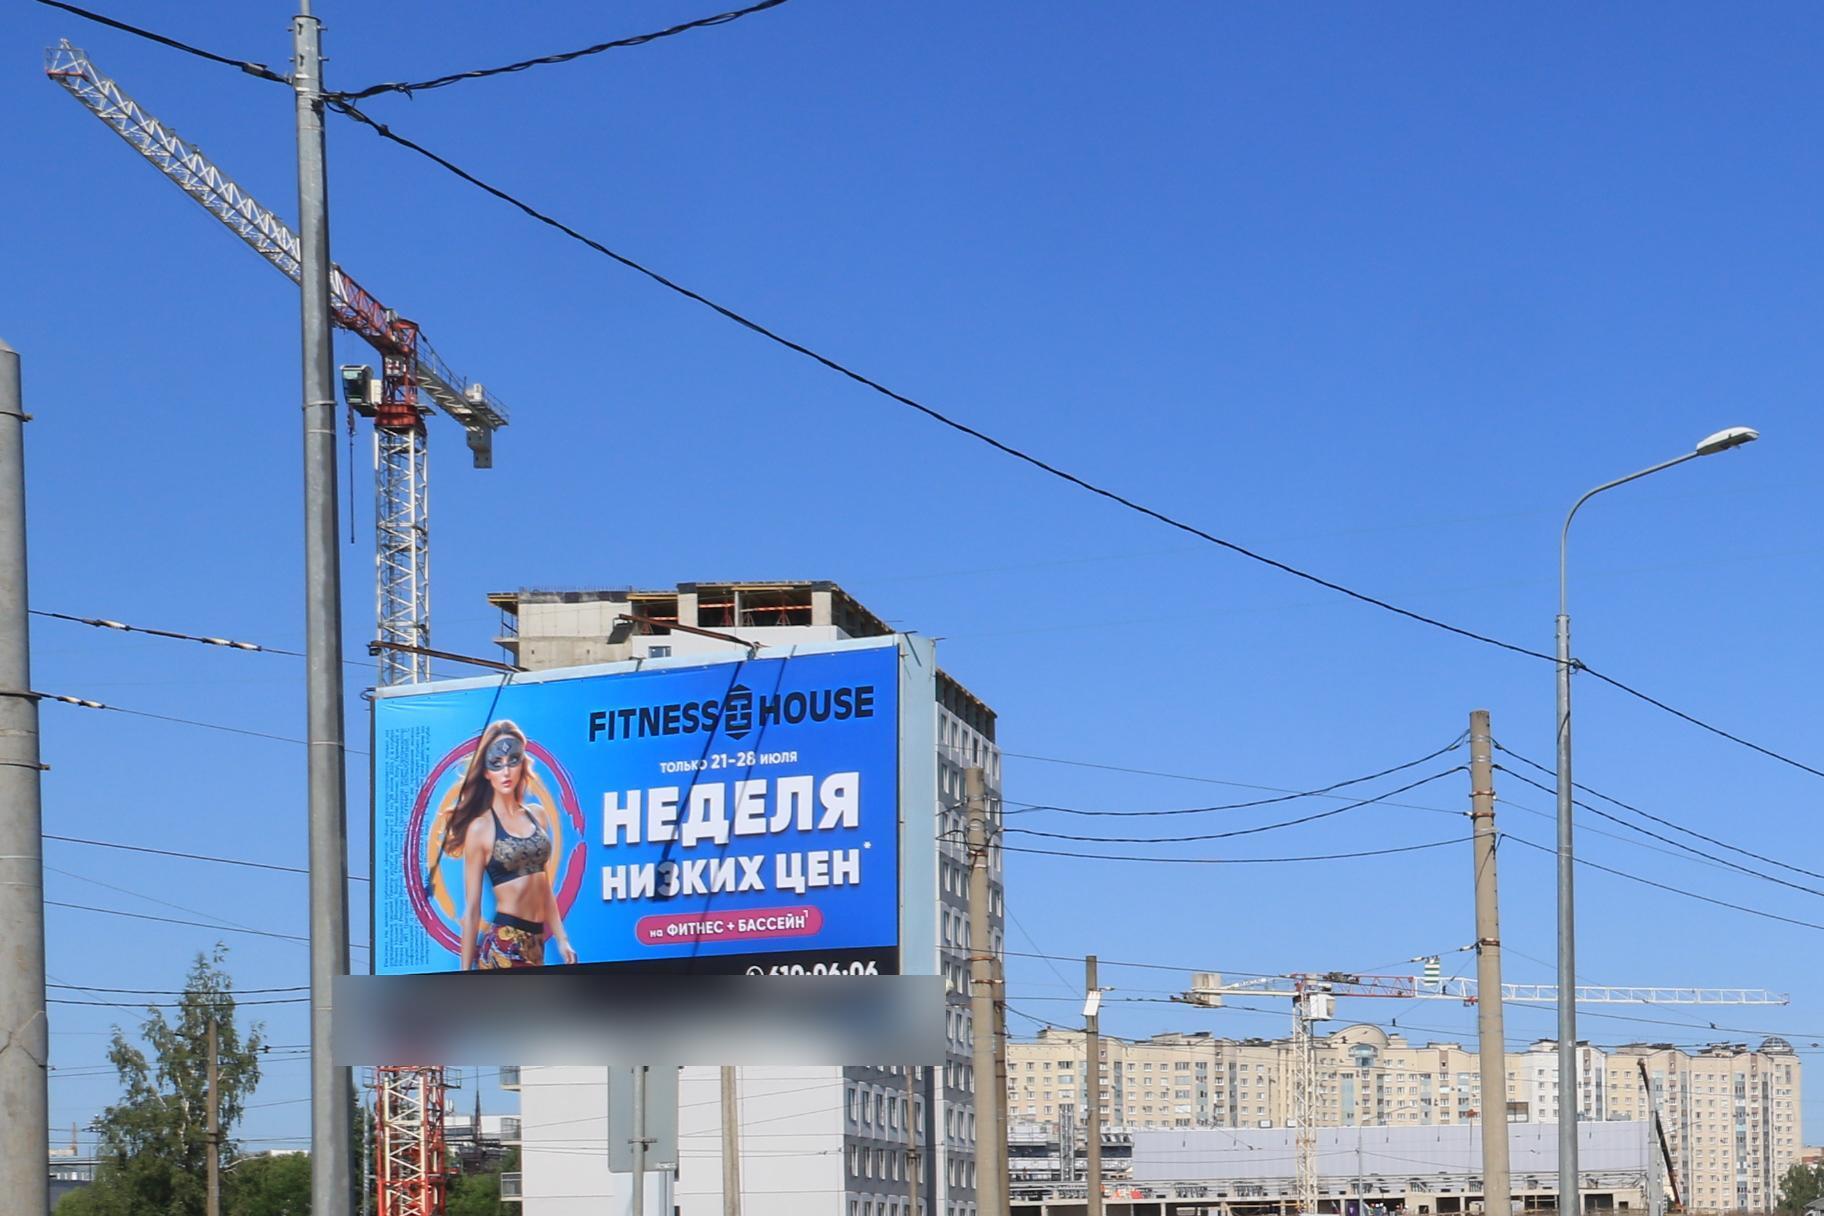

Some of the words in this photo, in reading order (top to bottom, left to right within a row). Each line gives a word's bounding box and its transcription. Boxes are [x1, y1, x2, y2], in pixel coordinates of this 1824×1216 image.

[589, 700, 720, 742] FITNESS
[759, 686, 874, 727] HOUSE
[603, 771, 859, 848] НЕДЕЛЯ
[602, 855, 766, 900] НИЗКИХ
[650, 929, 664, 938] на
[667, 920, 724, 936] ФИТНЕС
